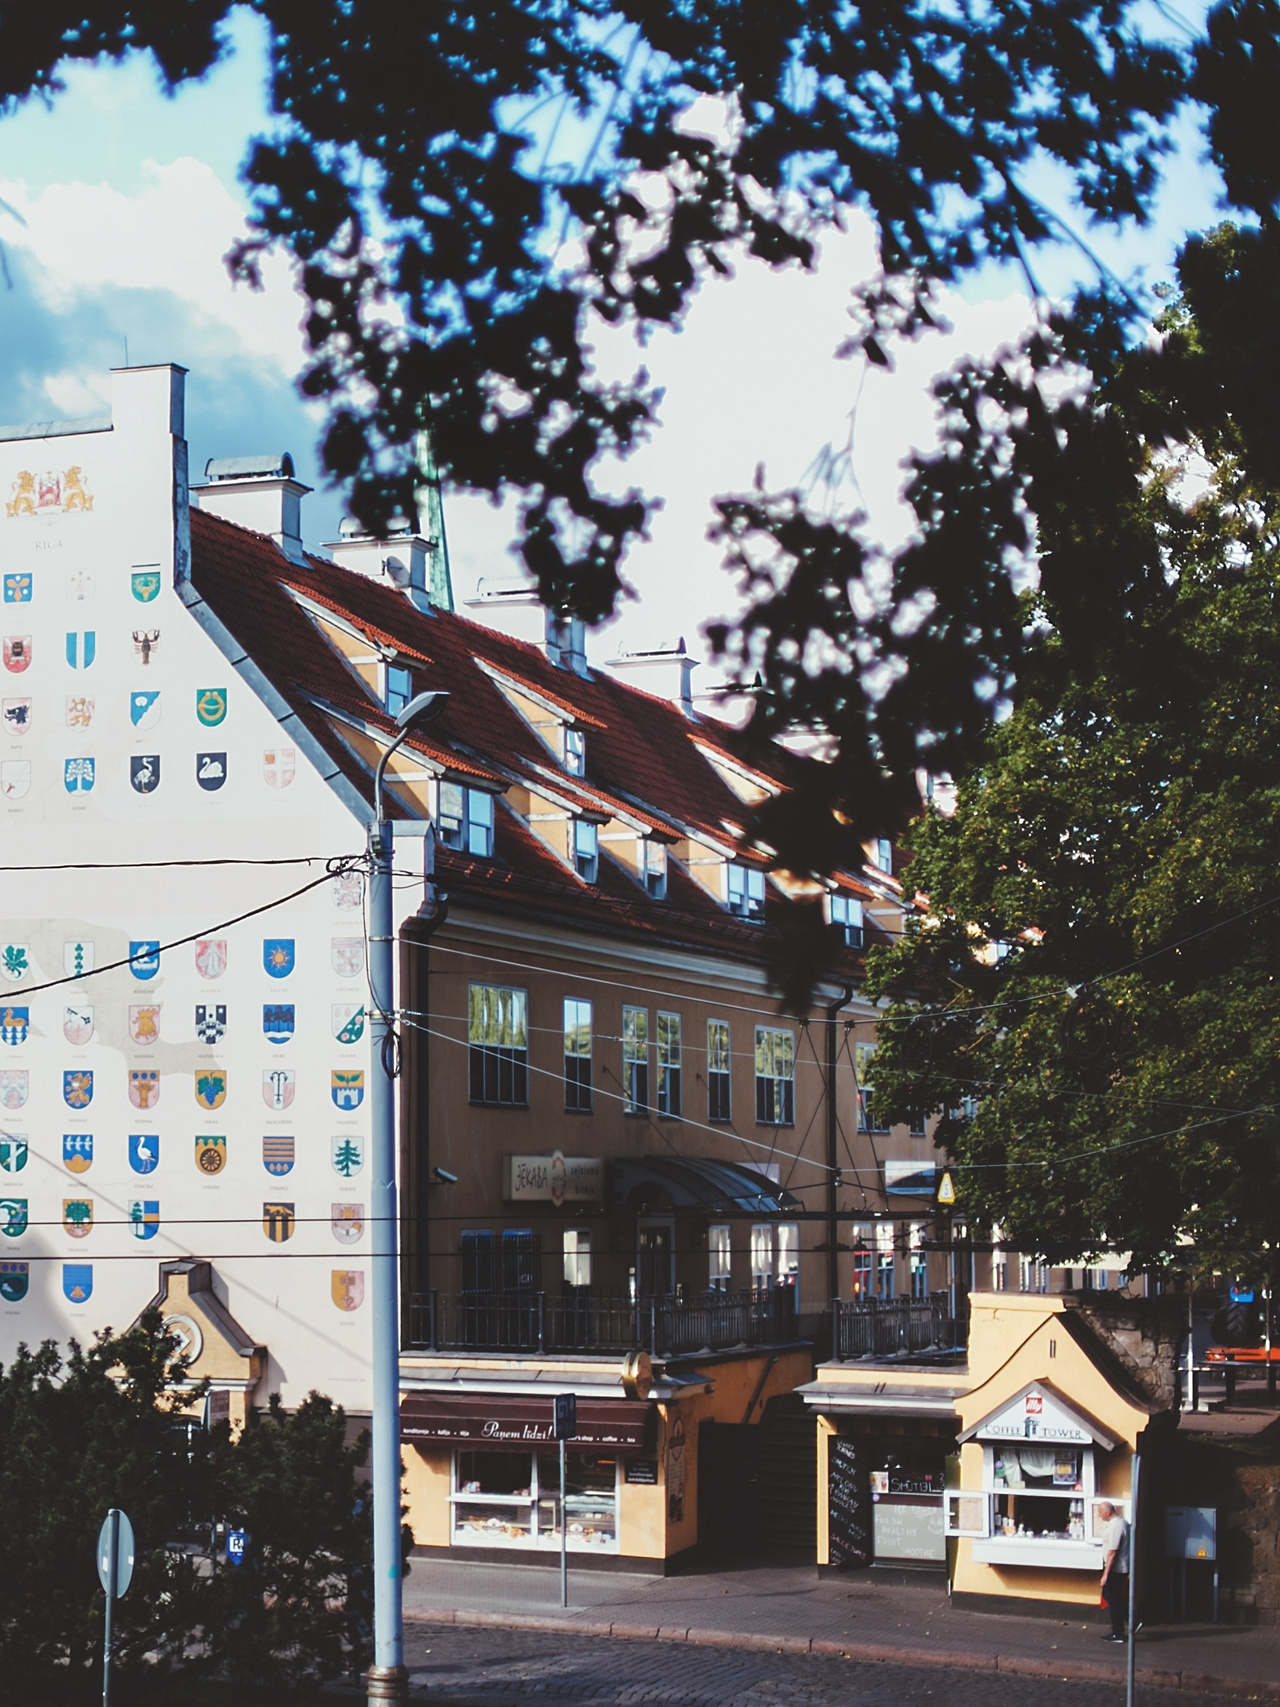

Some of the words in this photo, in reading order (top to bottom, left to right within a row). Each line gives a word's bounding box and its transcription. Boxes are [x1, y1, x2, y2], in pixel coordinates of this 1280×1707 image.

[1026, 1399, 1042, 1413] illy
[985, 1424, 1020, 1435] COFFEE
[1042, 1428, 1082, 1439] TOWER
